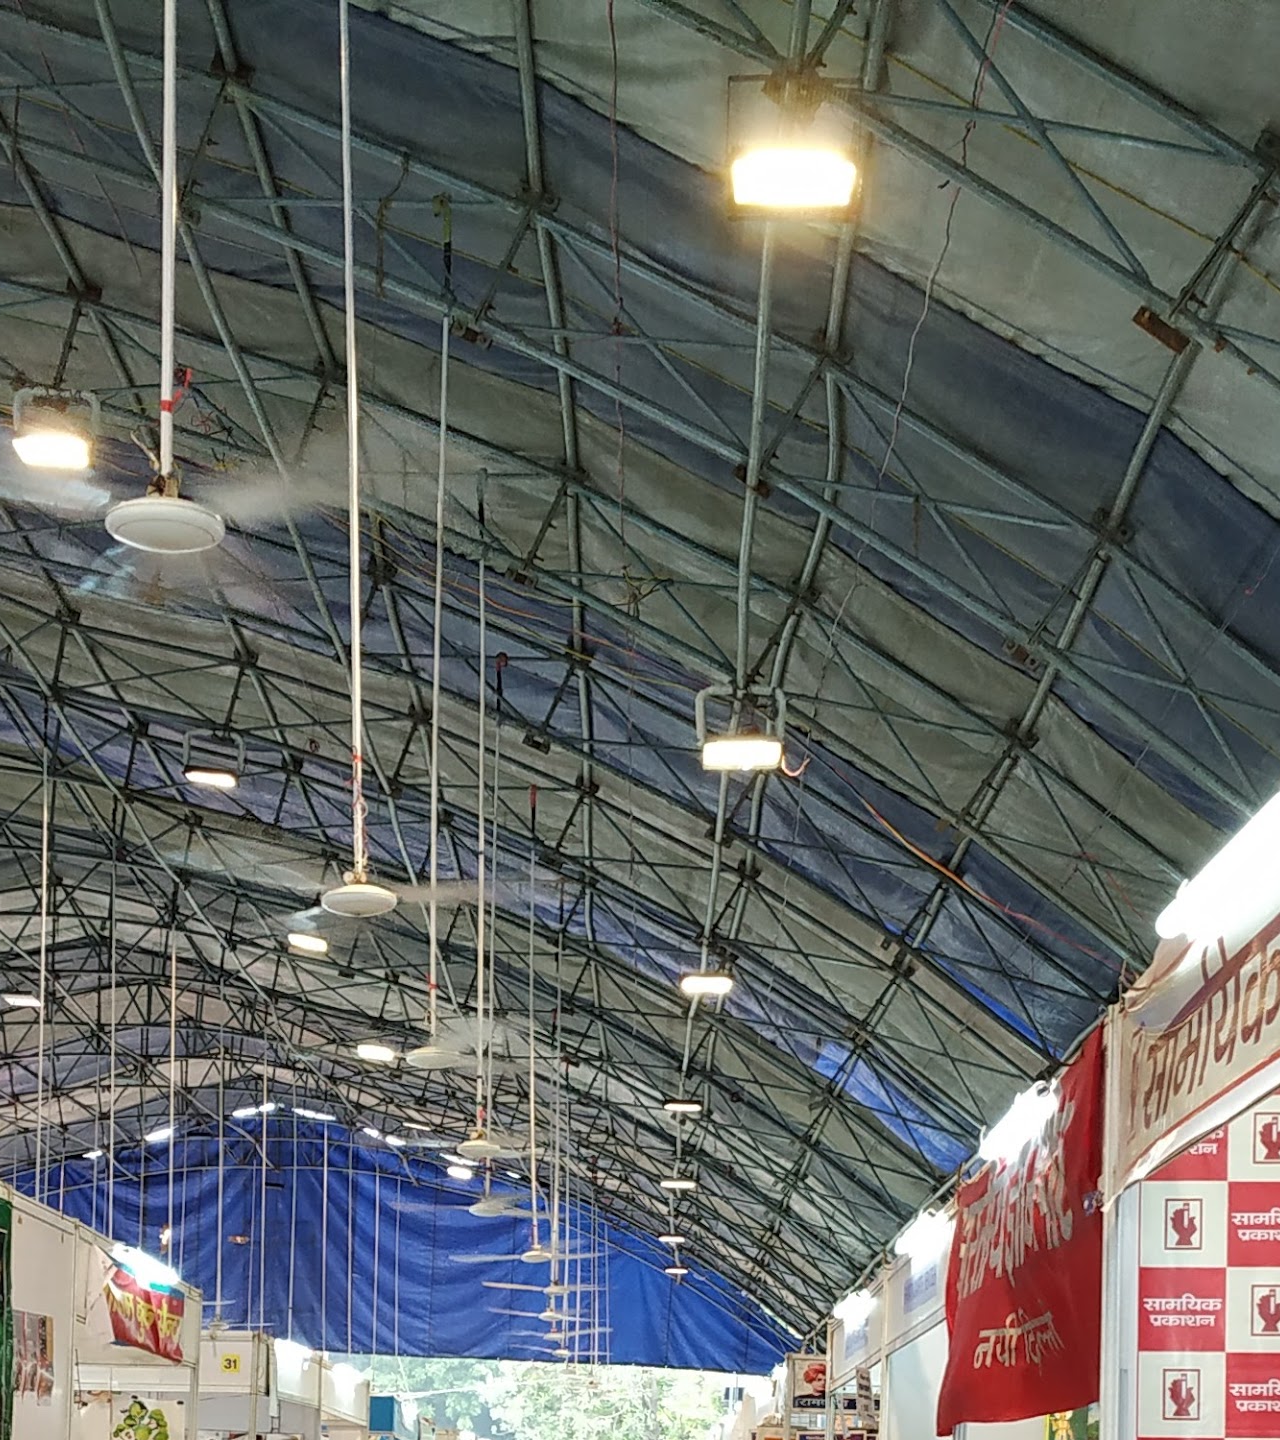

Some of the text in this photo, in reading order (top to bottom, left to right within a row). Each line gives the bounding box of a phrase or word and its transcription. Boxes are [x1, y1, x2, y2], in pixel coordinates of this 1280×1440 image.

[1143, 1292, 1223, 1312] सामयिक
[1149, 1314, 1216, 1327] प्रकाशन
[974, 1311, 1020, 1369] नयी
[224, 1358, 238, 1370] 31
